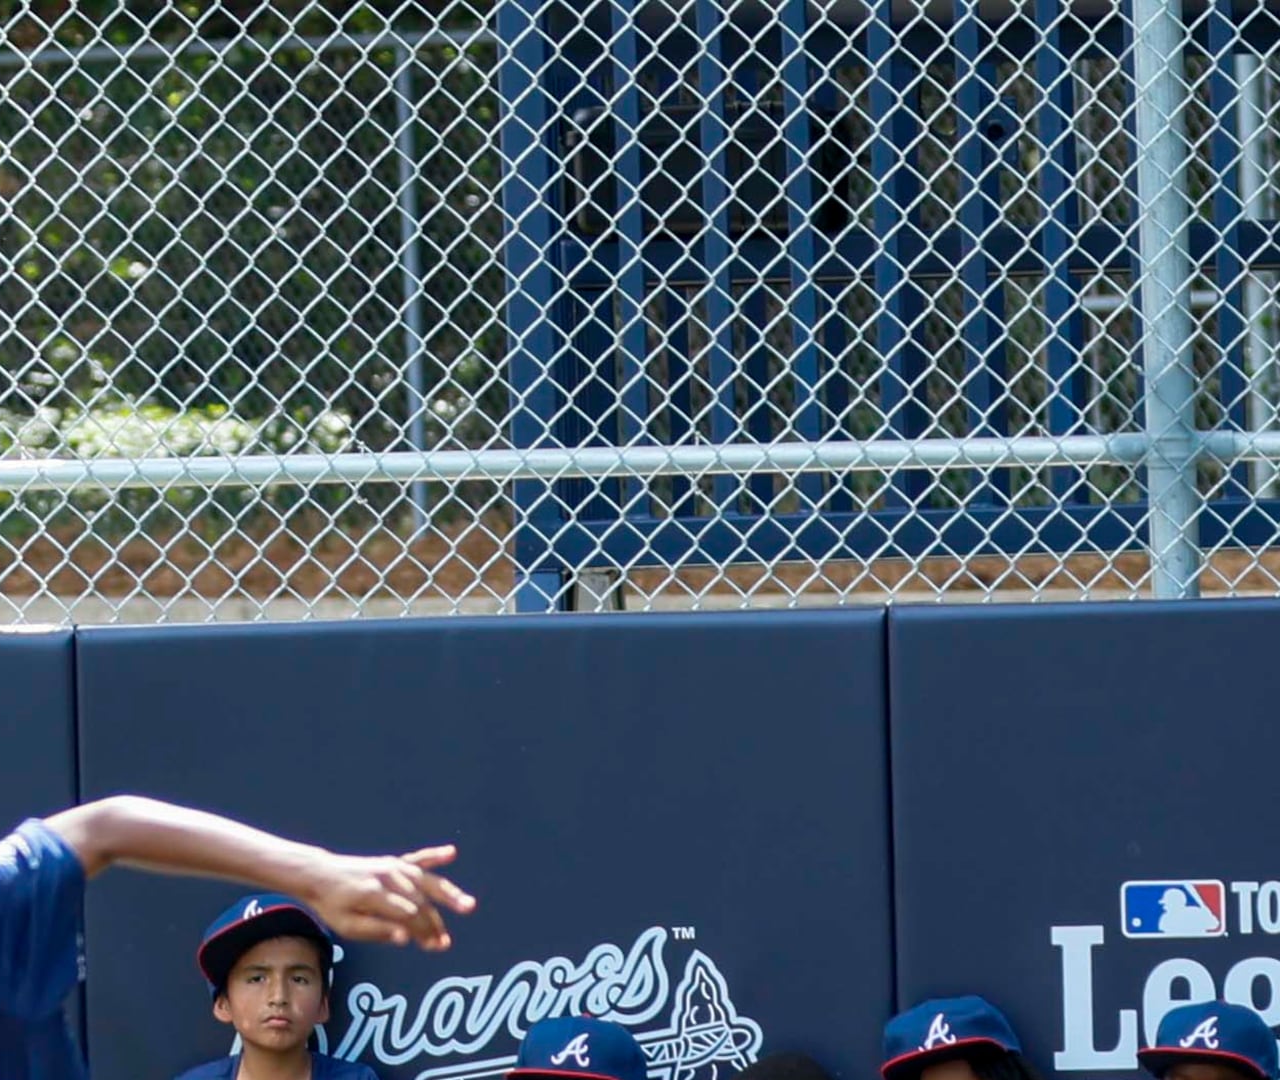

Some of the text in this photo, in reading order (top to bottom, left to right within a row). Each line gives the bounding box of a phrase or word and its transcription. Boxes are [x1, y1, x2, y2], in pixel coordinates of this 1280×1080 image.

[326, 925, 669, 1066] raves
[550, 1032, 590, 1068] A
[918, 1012, 957, 1052] A
[1179, 1015, 1219, 1049] A
